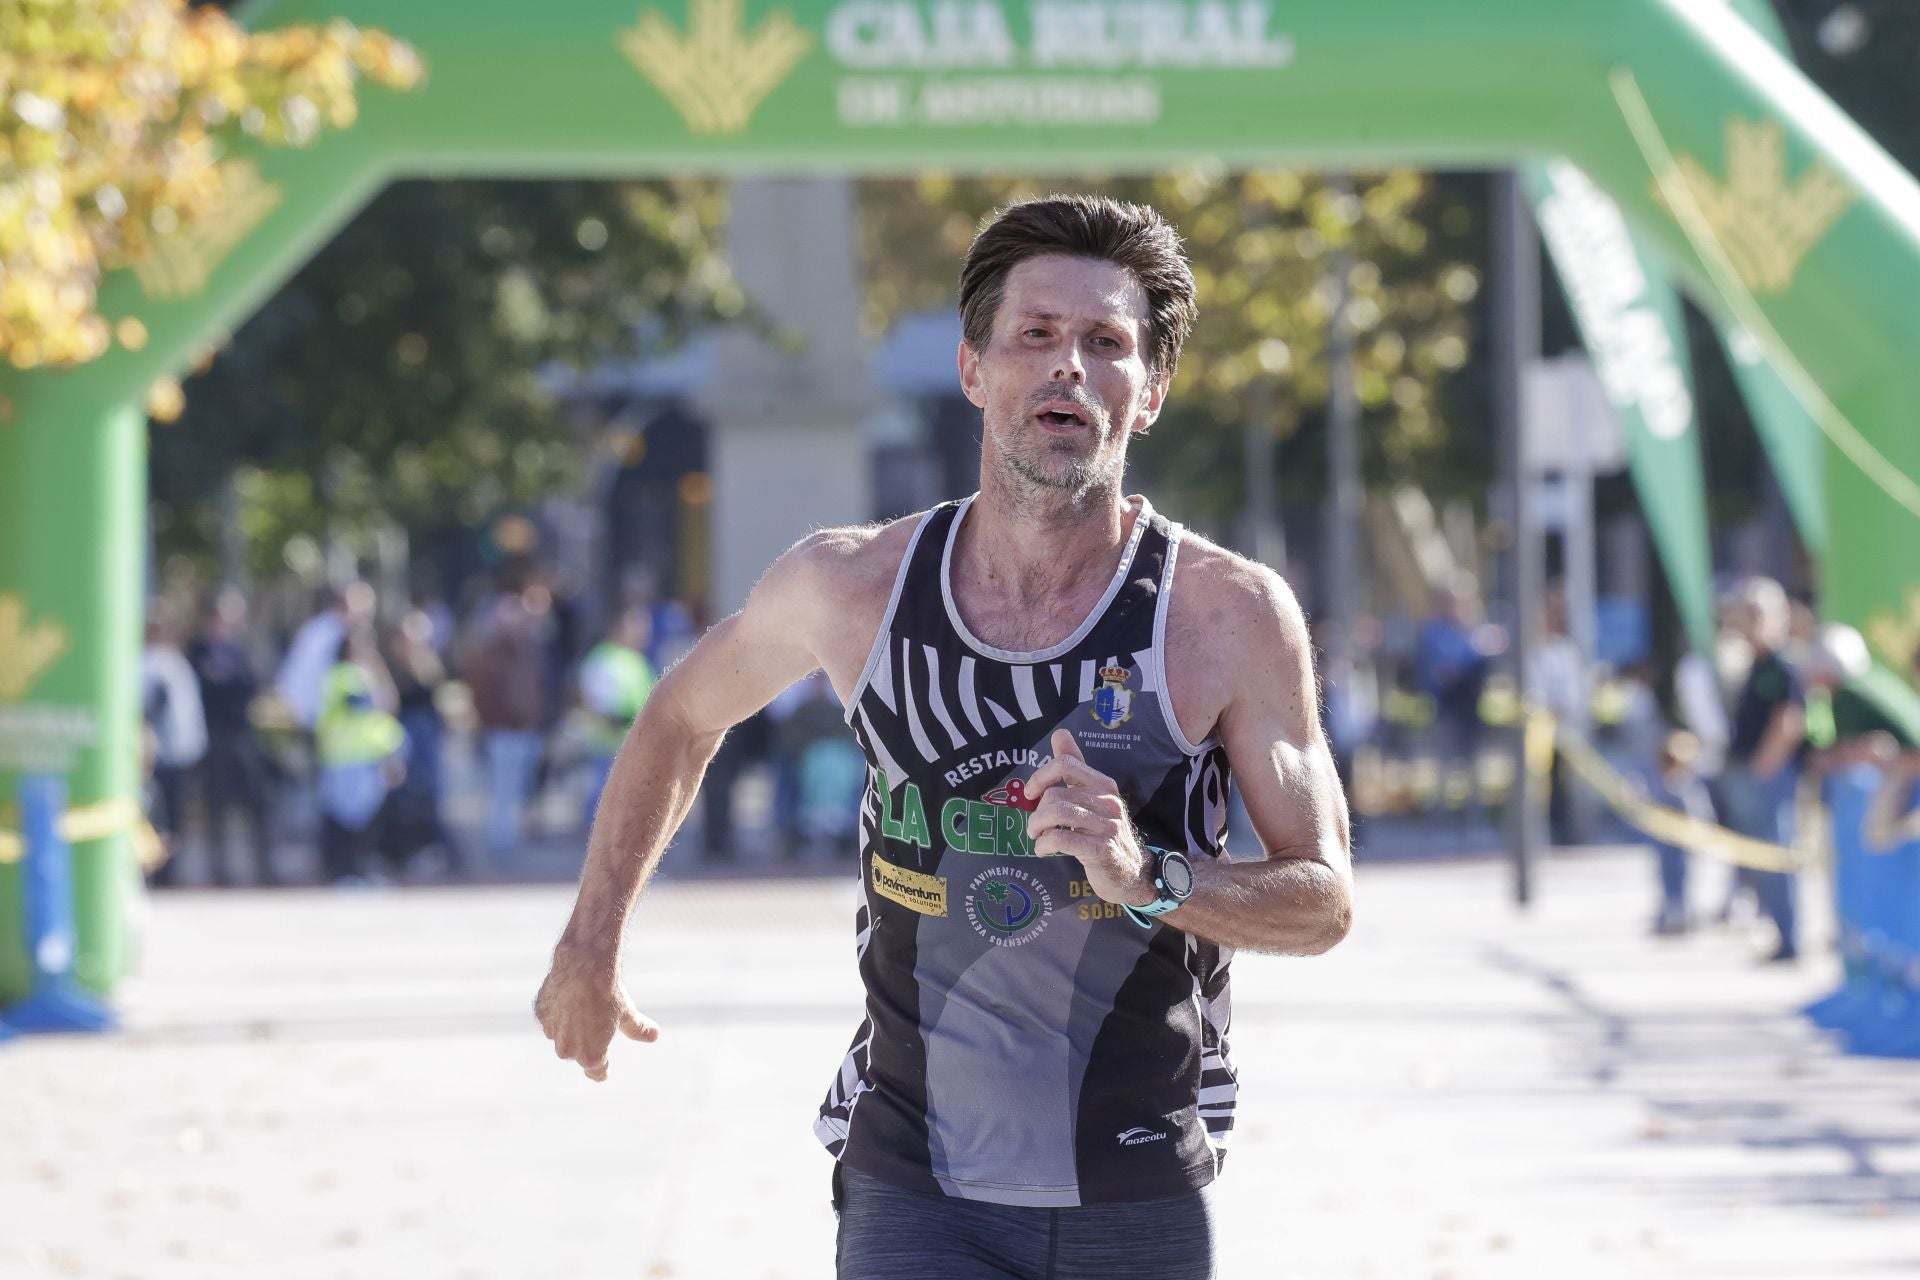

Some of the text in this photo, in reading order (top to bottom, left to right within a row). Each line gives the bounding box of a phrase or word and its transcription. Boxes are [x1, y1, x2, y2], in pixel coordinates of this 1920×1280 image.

[826, 0, 1294, 67] CAJA RURAL
[1078, 731, 1131, 740] AYUNTAMIENTO
[1085, 740, 1131, 750] RIBADESELLA
[876, 766, 932, 849] LA
[882, 875, 942, 902] pavimentum
[965, 866, 1052, 948] PAVIMENTOS VETUSTA PAVIMENTOS VETUSTA
